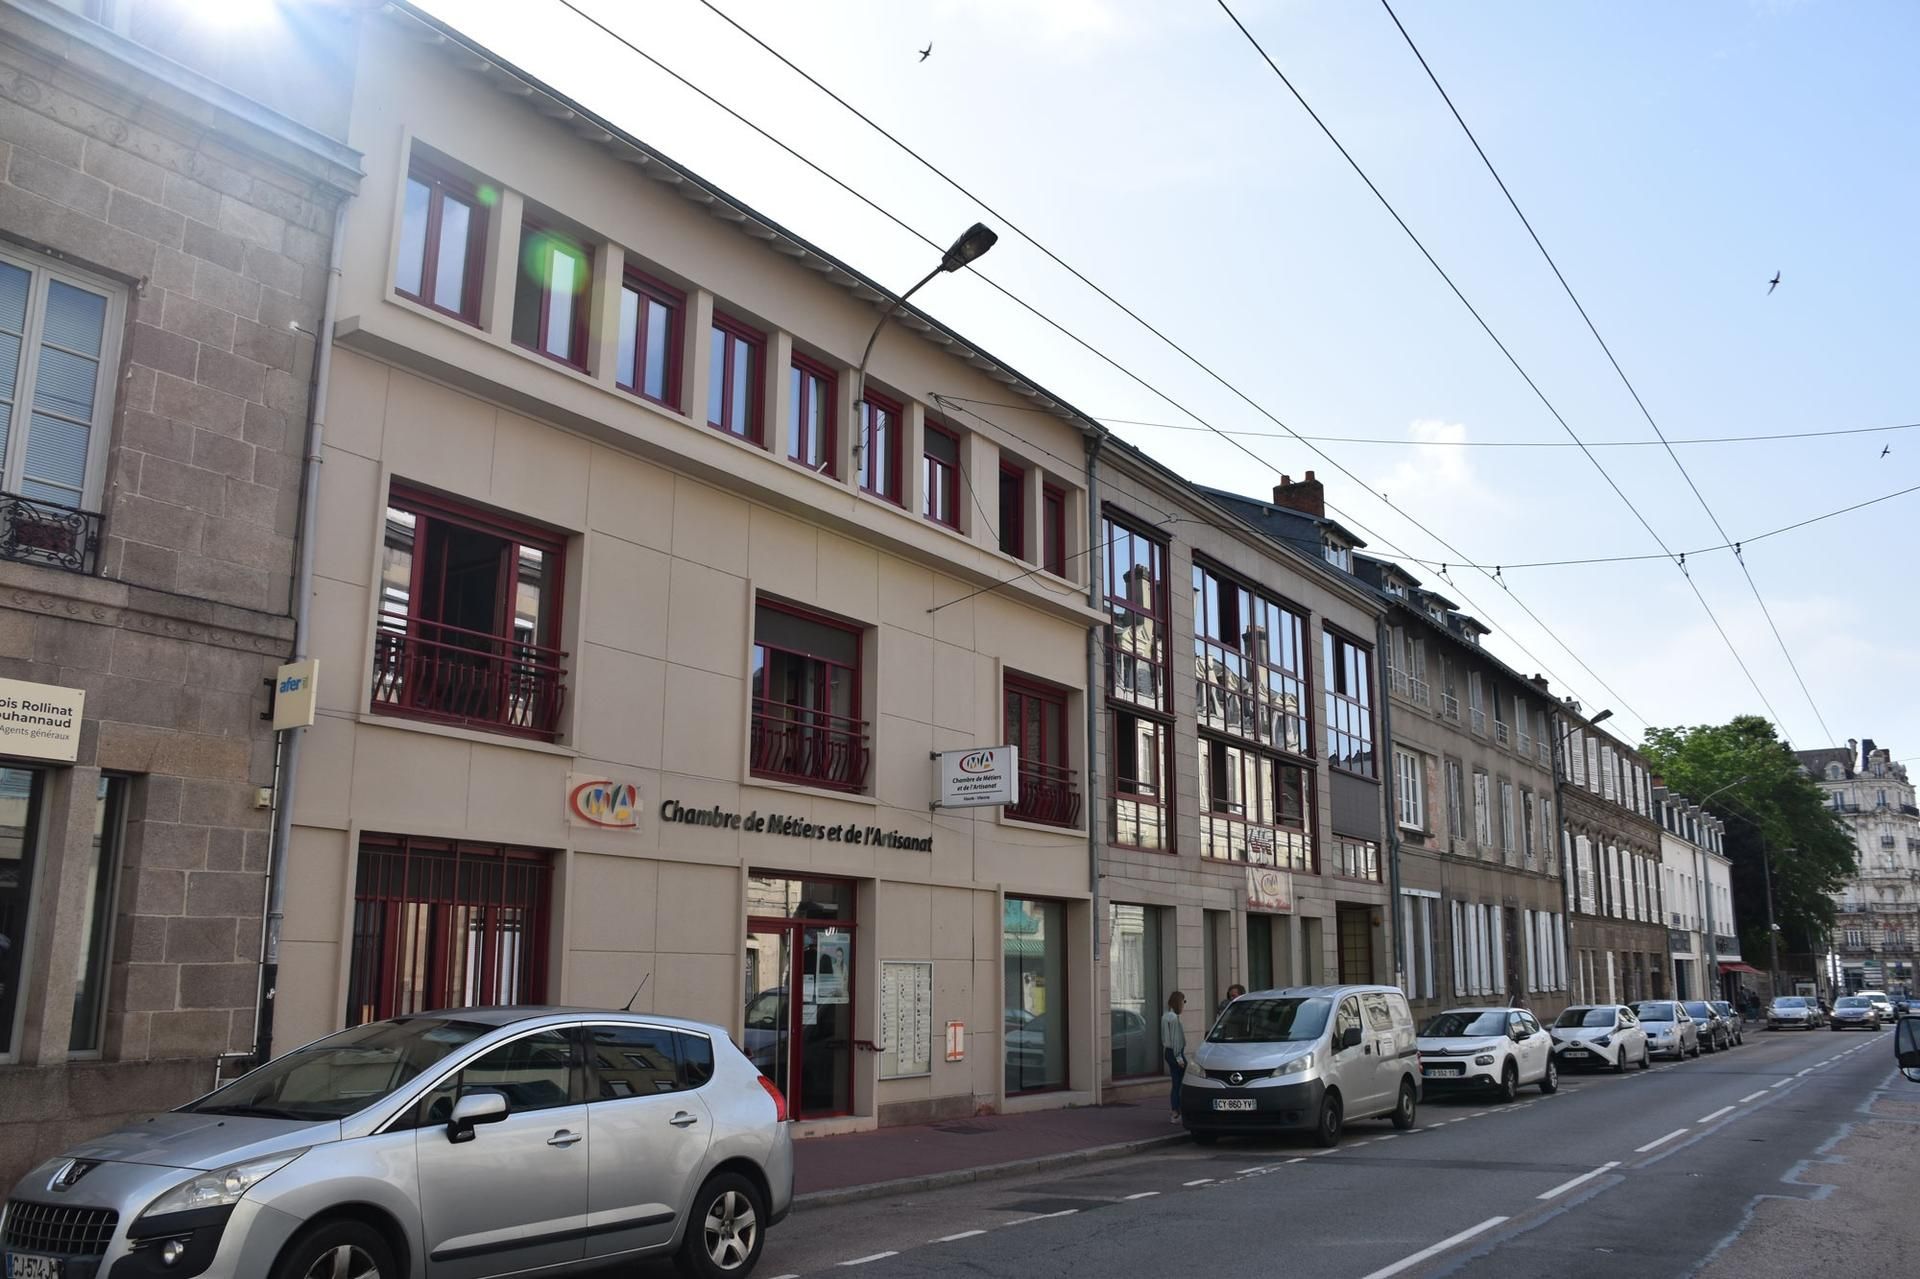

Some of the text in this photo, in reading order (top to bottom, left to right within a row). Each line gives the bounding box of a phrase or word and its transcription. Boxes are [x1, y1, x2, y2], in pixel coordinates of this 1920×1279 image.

[280, 676, 302, 693] afer
[22, 700, 73, 716] Rollinat
[0, 711, 72, 728] uhannaud
[0, 725, 70, 740] Agents généraux
[952, 776, 975, 784] Chambre
[661, 800, 932, 852] Chambre de Métiers et de l'Artisanat
